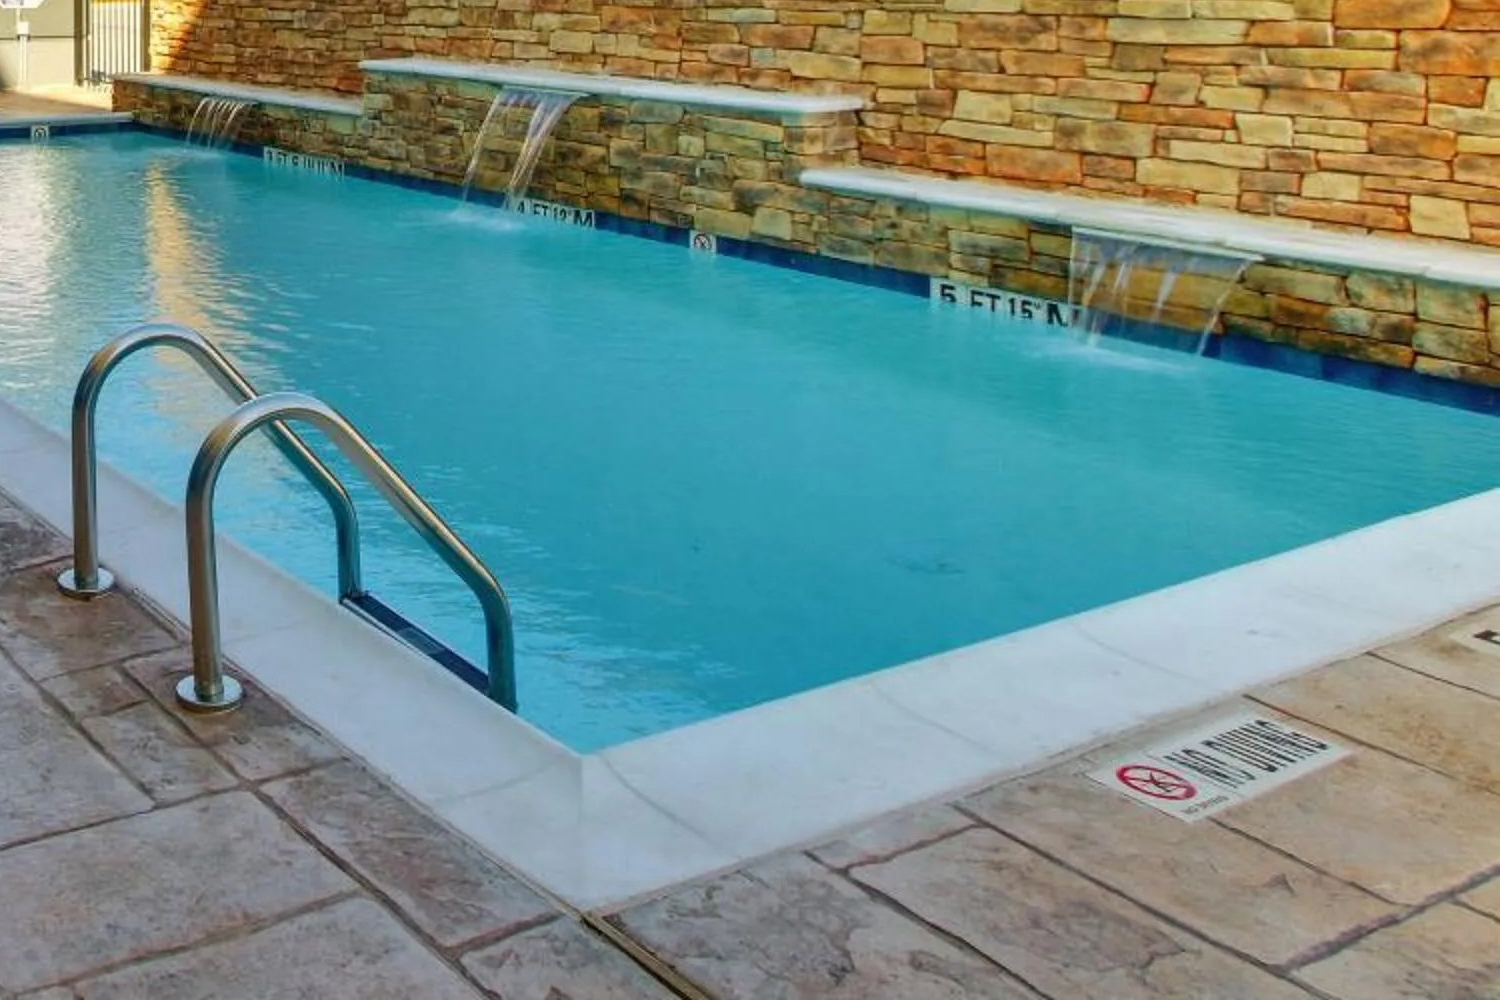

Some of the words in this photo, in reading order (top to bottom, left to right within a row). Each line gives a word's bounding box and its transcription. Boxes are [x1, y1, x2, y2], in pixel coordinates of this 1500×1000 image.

[573, 209, 593, 228] M
[940, 283, 957, 304] 5
[970, 289, 1002, 313] FT
[1200, 719, 1330, 773] DIVING
[1163, 748, 1256, 789] NO
